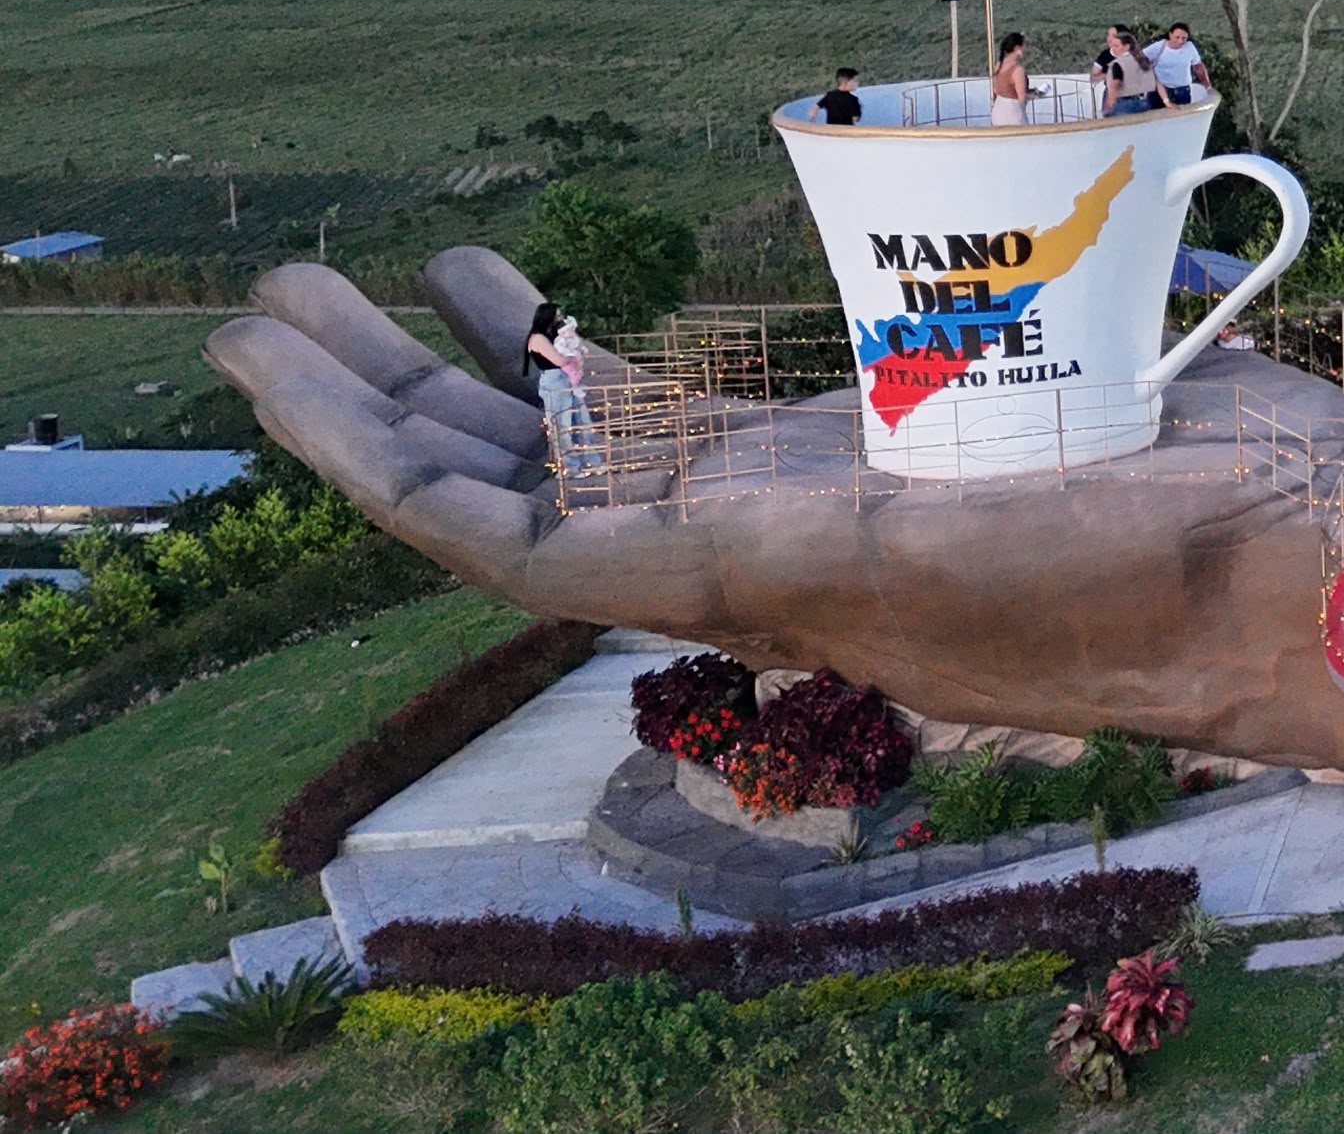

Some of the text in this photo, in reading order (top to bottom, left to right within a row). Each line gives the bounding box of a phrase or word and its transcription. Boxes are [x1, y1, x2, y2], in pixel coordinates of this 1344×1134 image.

[867, 231, 1033, 271] MANO
[898, 280, 1011, 314] DEL
[886, 309, 1043, 361] CAFÉ
[875, 359, 1082, 388] PITALITO HUILA
